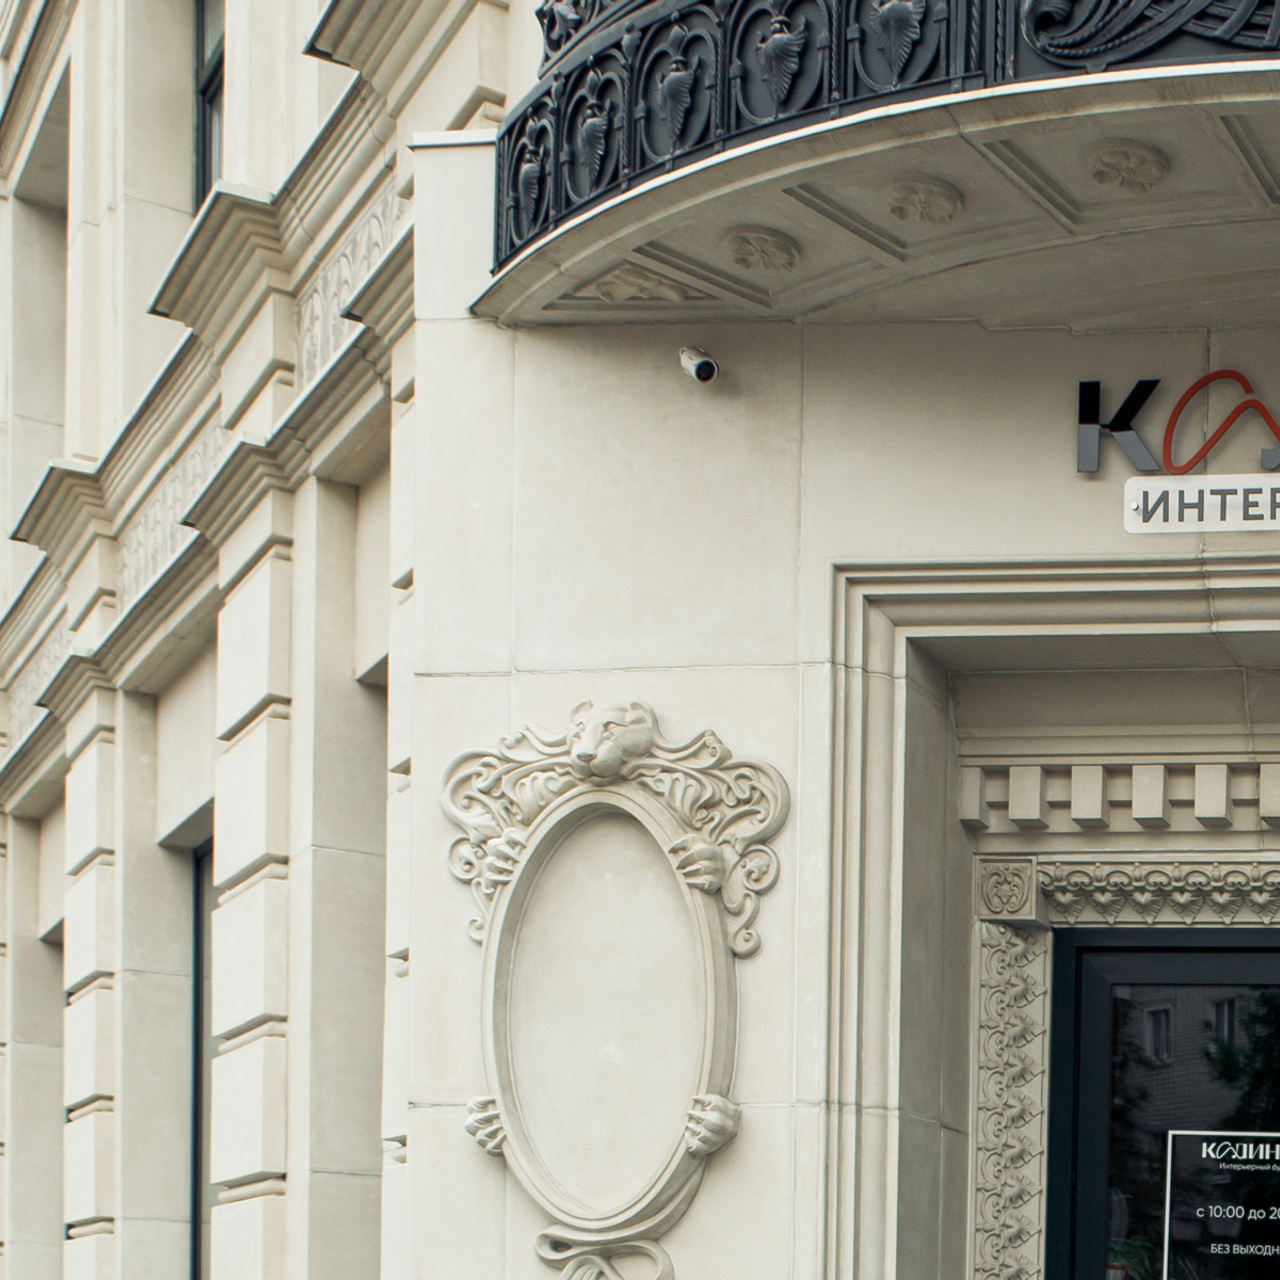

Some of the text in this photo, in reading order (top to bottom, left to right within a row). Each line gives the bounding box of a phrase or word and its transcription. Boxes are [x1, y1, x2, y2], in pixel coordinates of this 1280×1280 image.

[1219, 1162, 1271, 1171] Интерьерный
[1208, 1205, 1245, 1219] 10:00
[1247, 1209, 1266, 1221] до
[1210, 1243, 1231, 1255] БЕЗ
